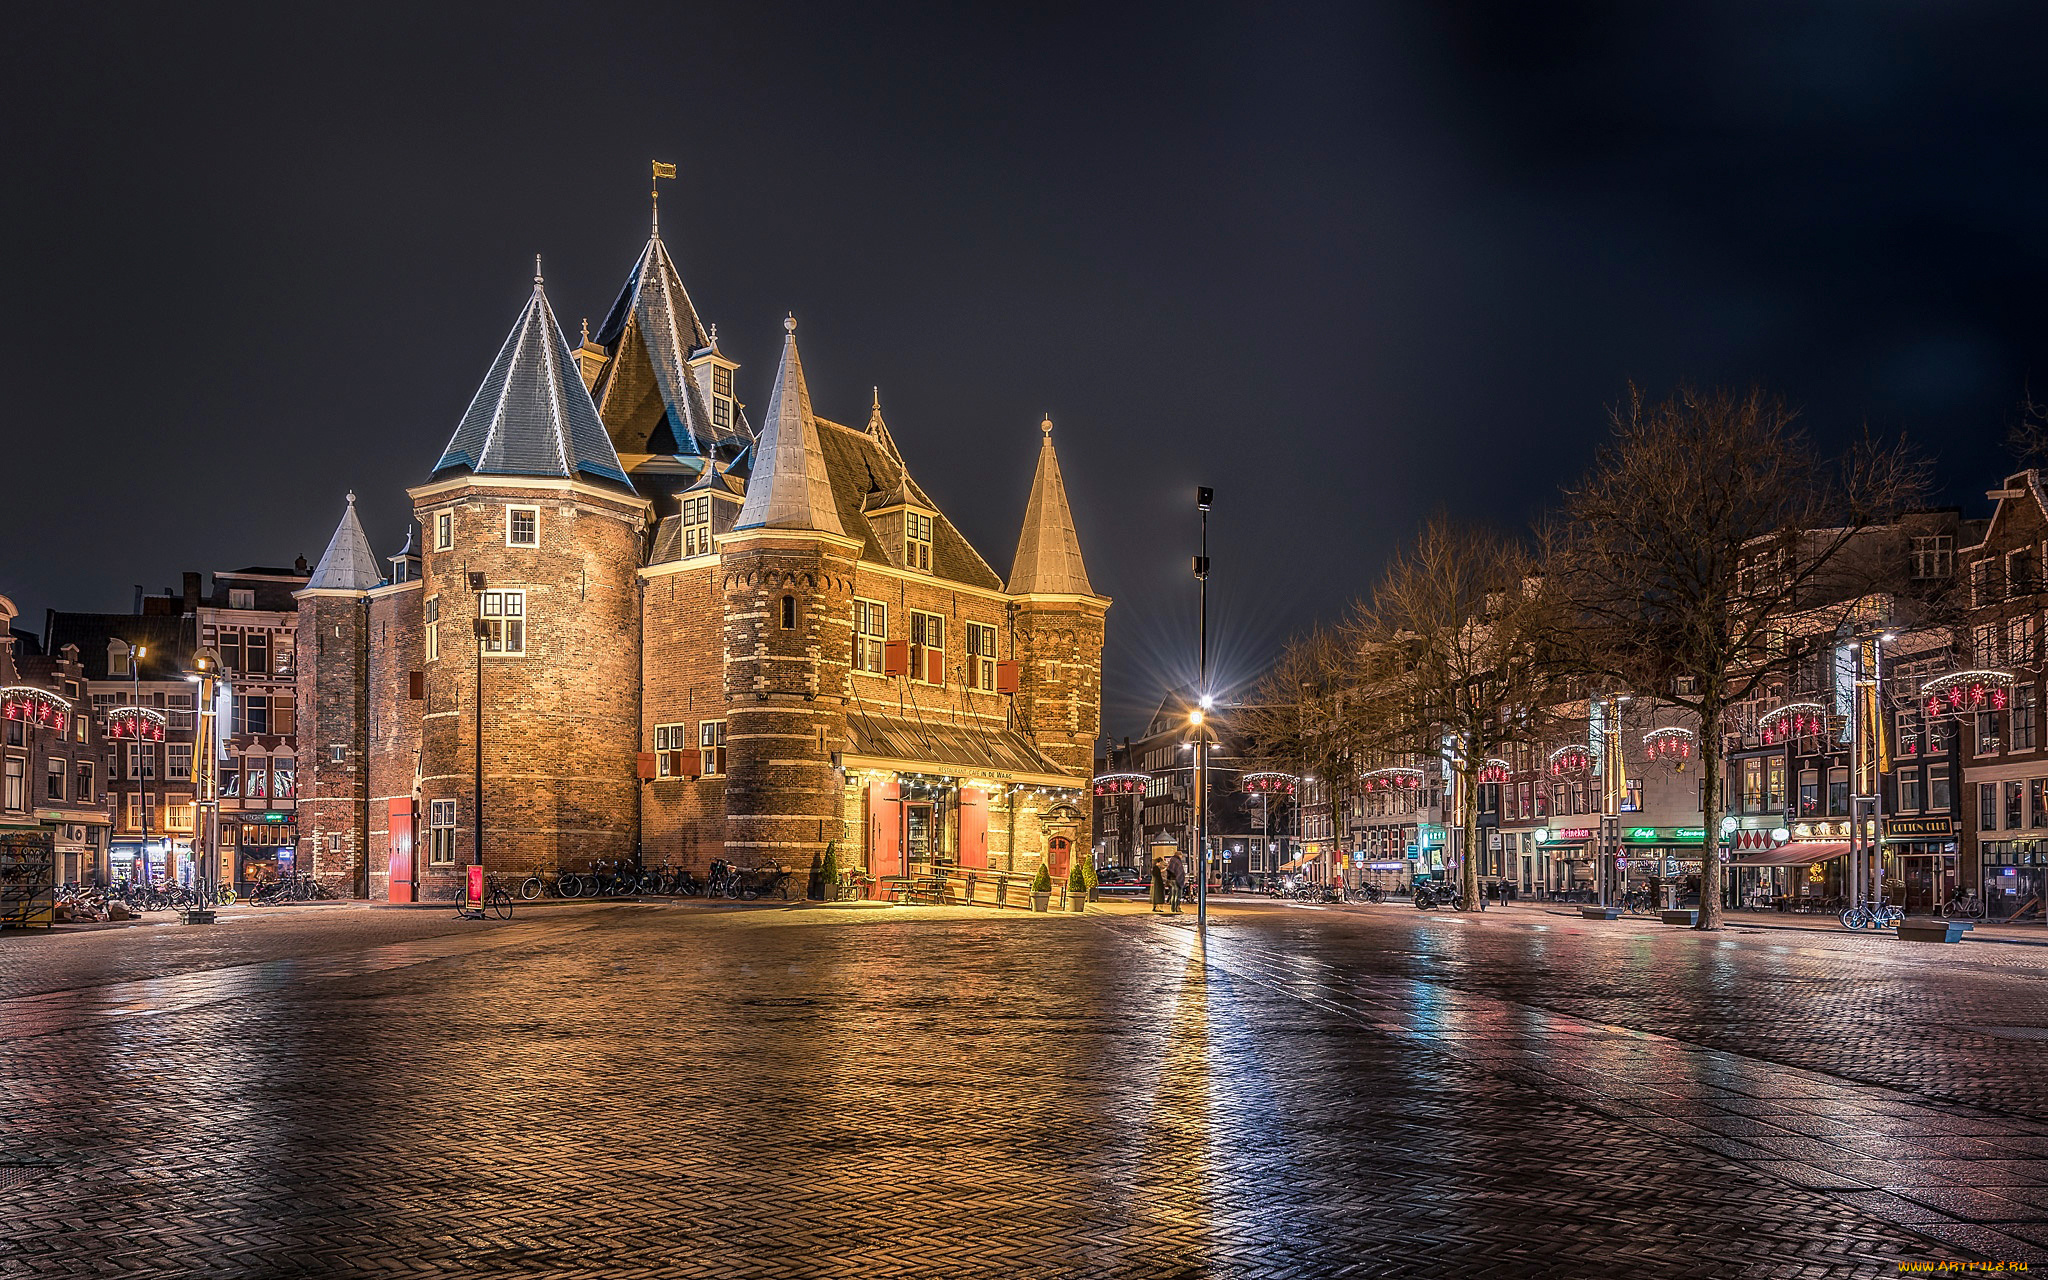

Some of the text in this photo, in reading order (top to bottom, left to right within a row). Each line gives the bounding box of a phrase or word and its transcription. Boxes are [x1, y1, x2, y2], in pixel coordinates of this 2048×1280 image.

[1893, 822, 1947, 832] COTTON CLUB
[1560, 828, 1589, 839] Heineken
